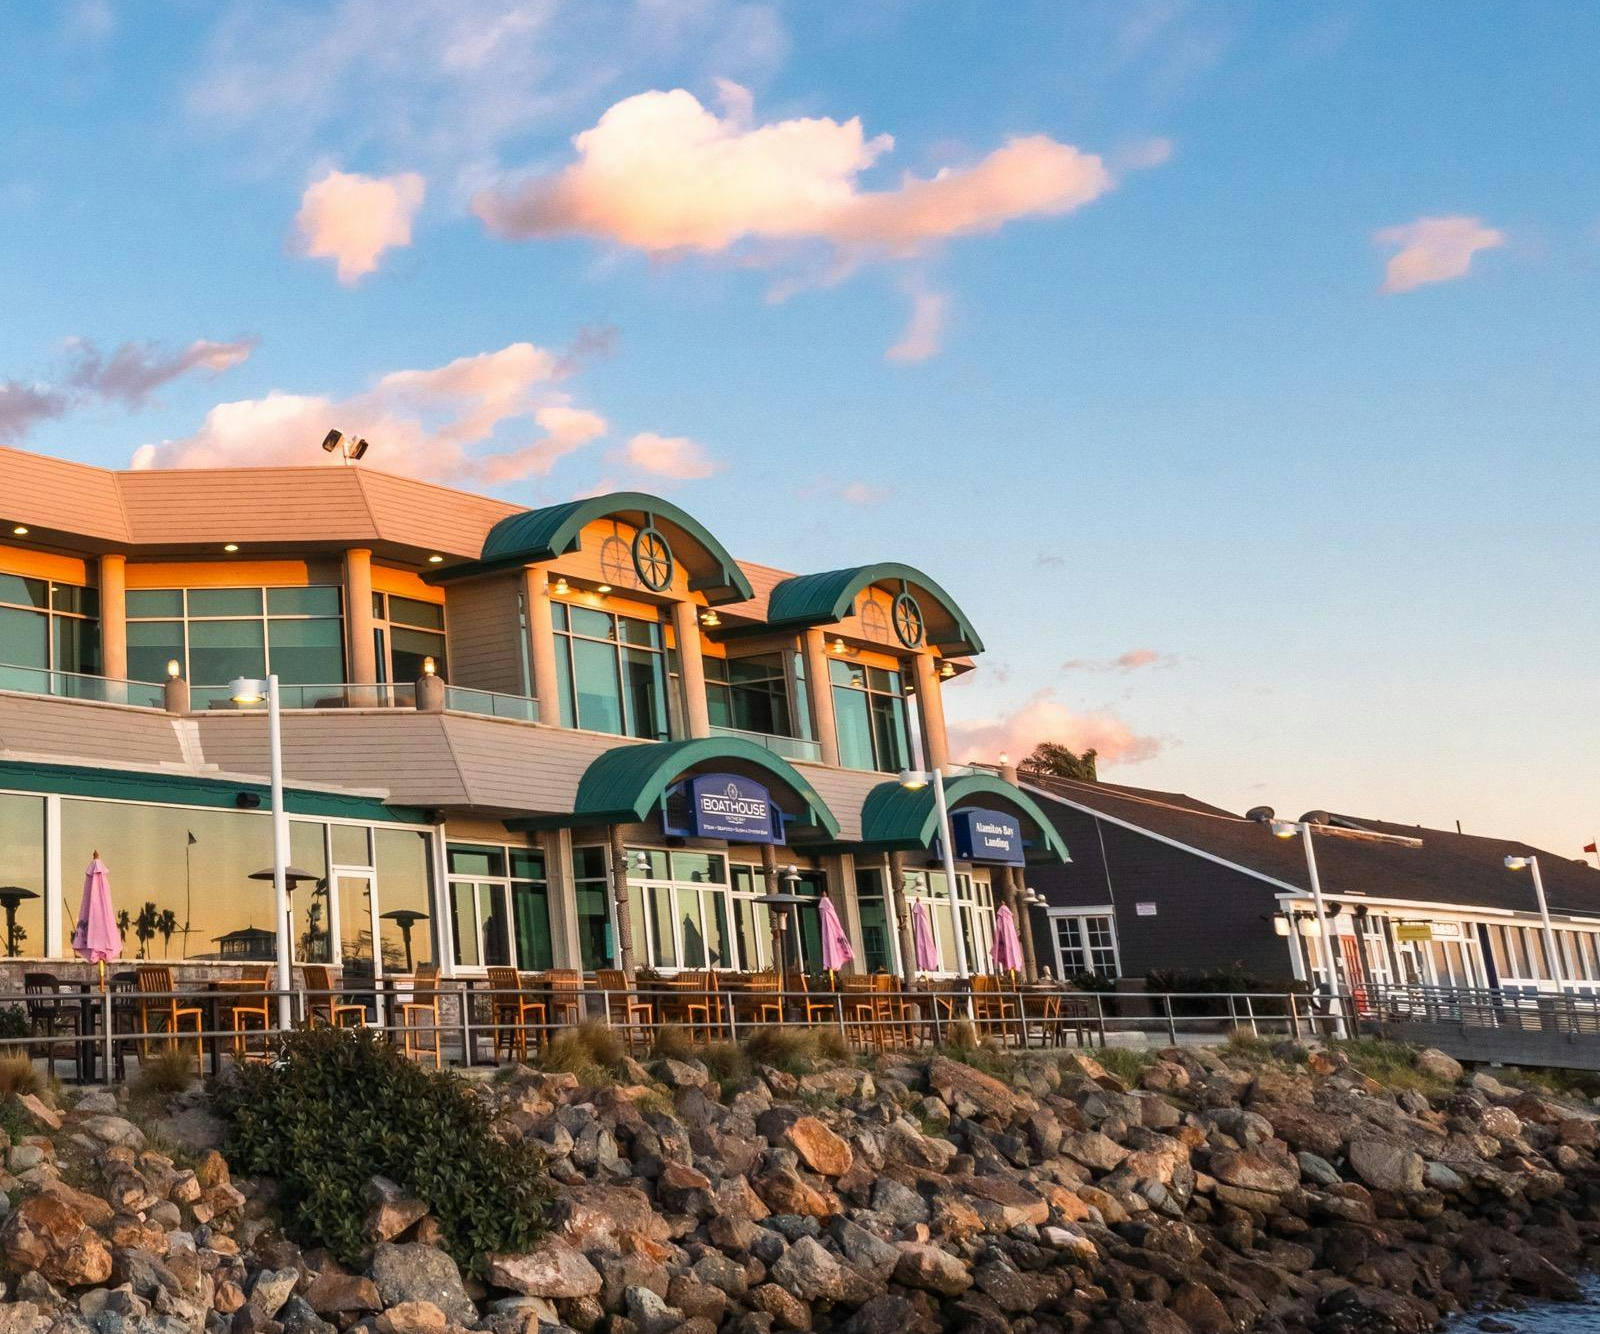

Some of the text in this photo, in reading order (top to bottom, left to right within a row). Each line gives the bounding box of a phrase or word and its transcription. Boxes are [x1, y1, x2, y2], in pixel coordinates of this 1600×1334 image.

[703, 798, 767, 816] BOATHOUSE
[976, 822, 1014, 838] Alamitos Bay
[984, 836, 1010, 851] Landing
